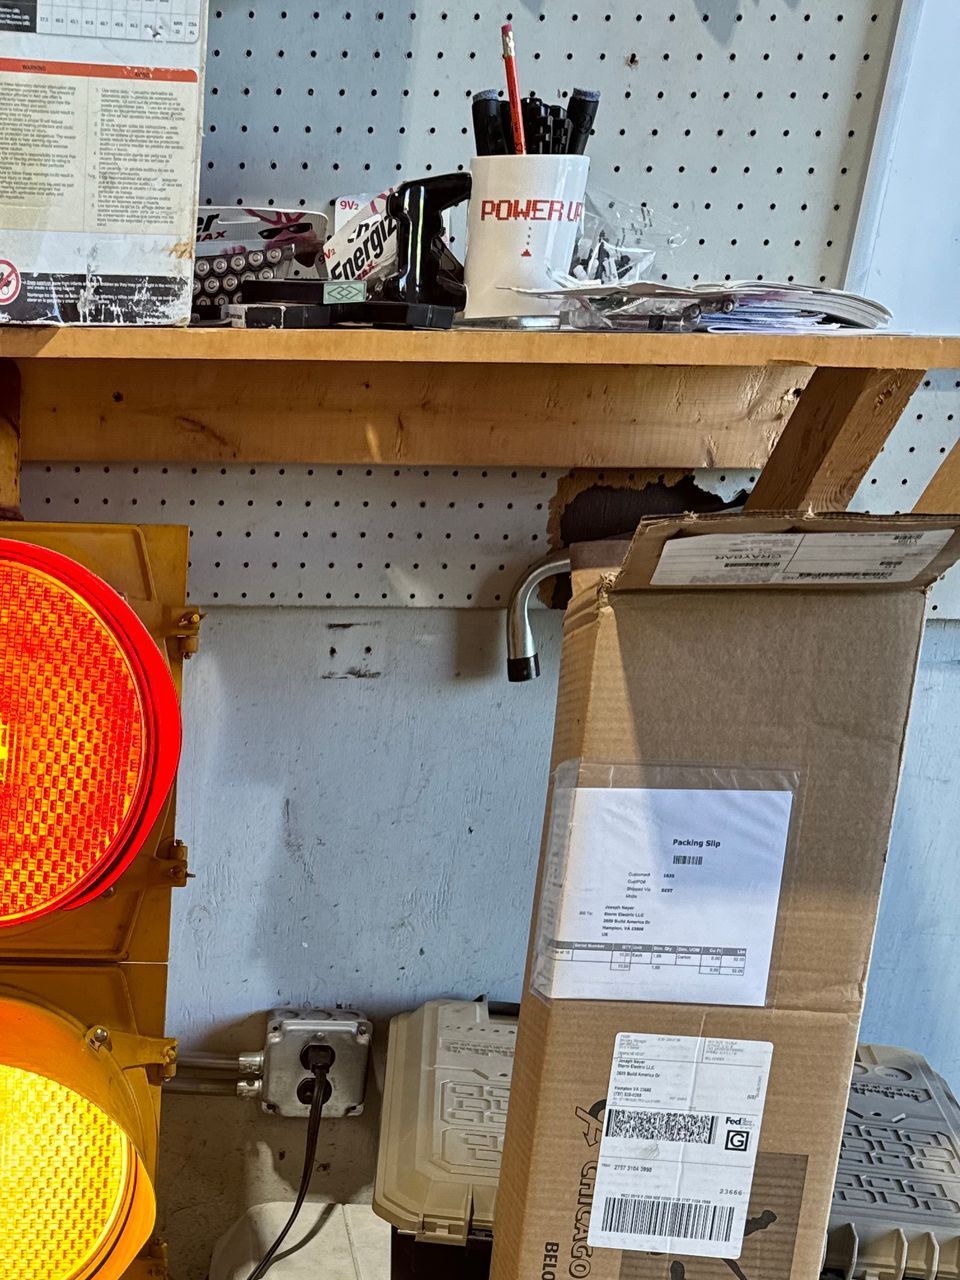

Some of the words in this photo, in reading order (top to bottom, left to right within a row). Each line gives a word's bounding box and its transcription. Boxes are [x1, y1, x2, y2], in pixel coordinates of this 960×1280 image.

[481, 199, 563, 221] POWER
[567, 200, 583, 221] UP
[330, 216, 397, 280] Energiz
[673, 839, 704, 848] Packing
[705, 839, 721, 848] Slip
[730, 1133, 745, 1147] G
[719, 1188, 742, 1196] 23666
[569, 1160, 598, 1279] CHICAGO
